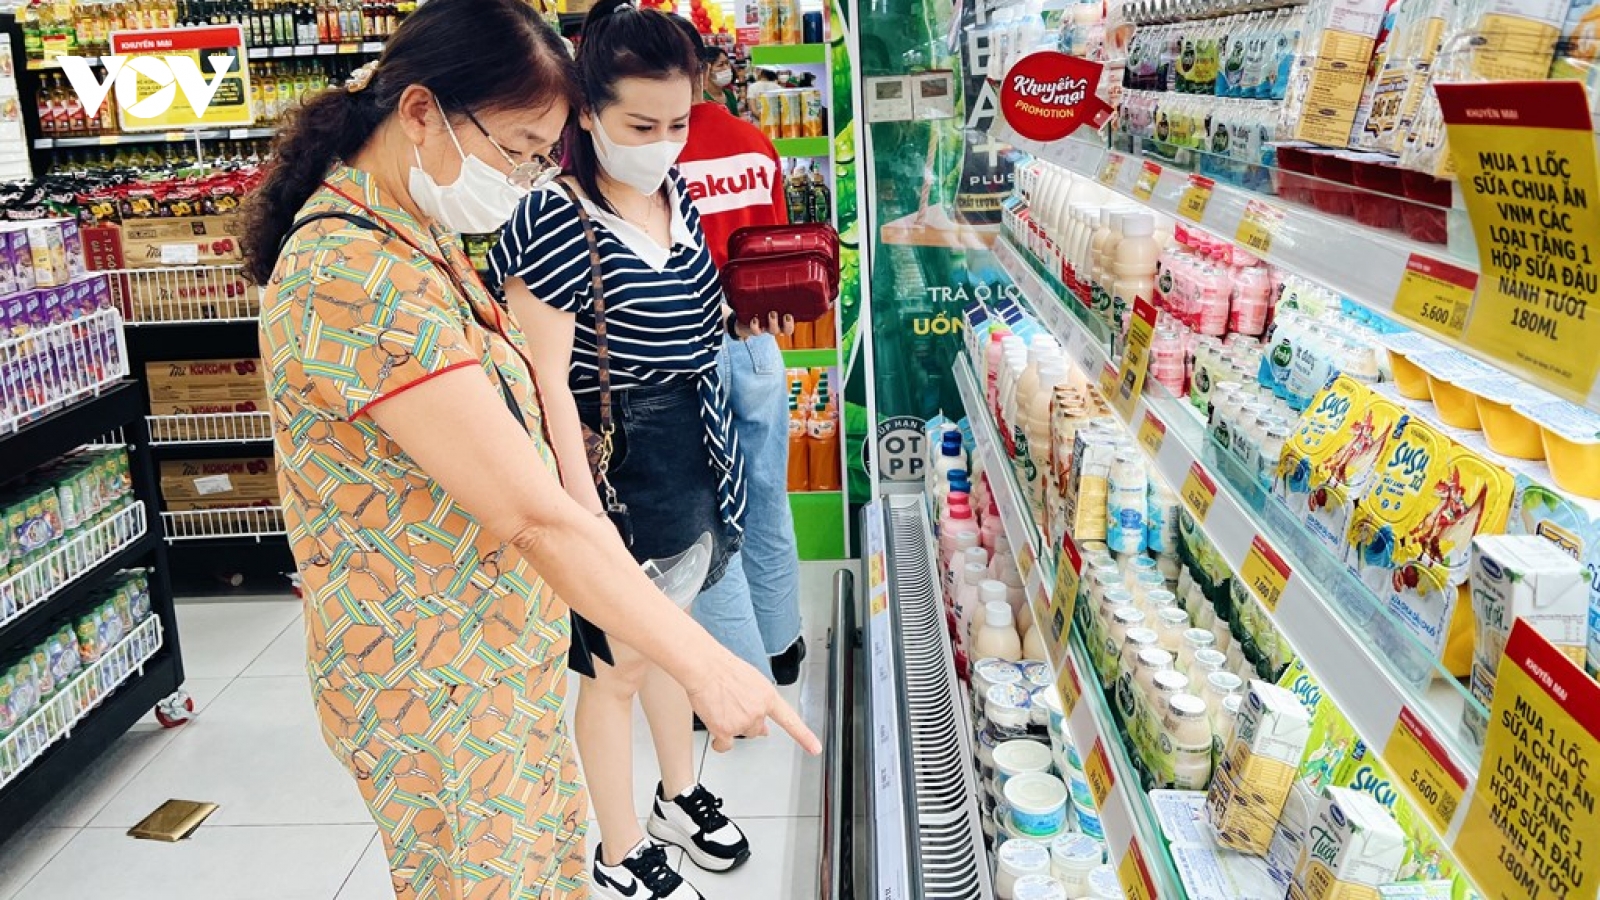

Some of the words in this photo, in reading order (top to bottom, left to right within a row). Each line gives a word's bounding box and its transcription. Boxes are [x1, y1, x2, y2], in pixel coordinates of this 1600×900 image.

[1014, 74, 1088, 103] Khuyến
[1053, 86, 1085, 106] mại
[1015, 100, 1075, 118] PROMOTION
[1478, 152, 1517, 173] MUA
[1521, 155, 1533, 175] 1
[687, 165, 770, 200] akult
[970, 173, 1014, 186] PLUS
[1511, 178, 1558, 203] CHUA
[1497, 202, 1535, 226] VNM
[1539, 204, 1573, 233] CÁC
[1582, 244, 1592, 265] 1
[1562, 263, 1598, 296] ĐẬU
[927, 283, 969, 302] TRÀ
[913, 310, 965, 335] UỐN
[1421, 302, 1449, 324] 5.600
[1511, 307, 1558, 341] 180ML
[189, 363, 232, 376] KOKOMI
[889, 457, 924, 476] PP
[1514, 694, 1545, 736] MUA
[1547, 728, 1556, 748] 1
[1532, 738, 1570, 789] CHUA
[1410, 769, 1438, 806] 5.600
[1513, 744, 1543, 788] VNM
[1547, 782, 1576, 822] CÁC
[1573, 840, 1583, 861] 1
